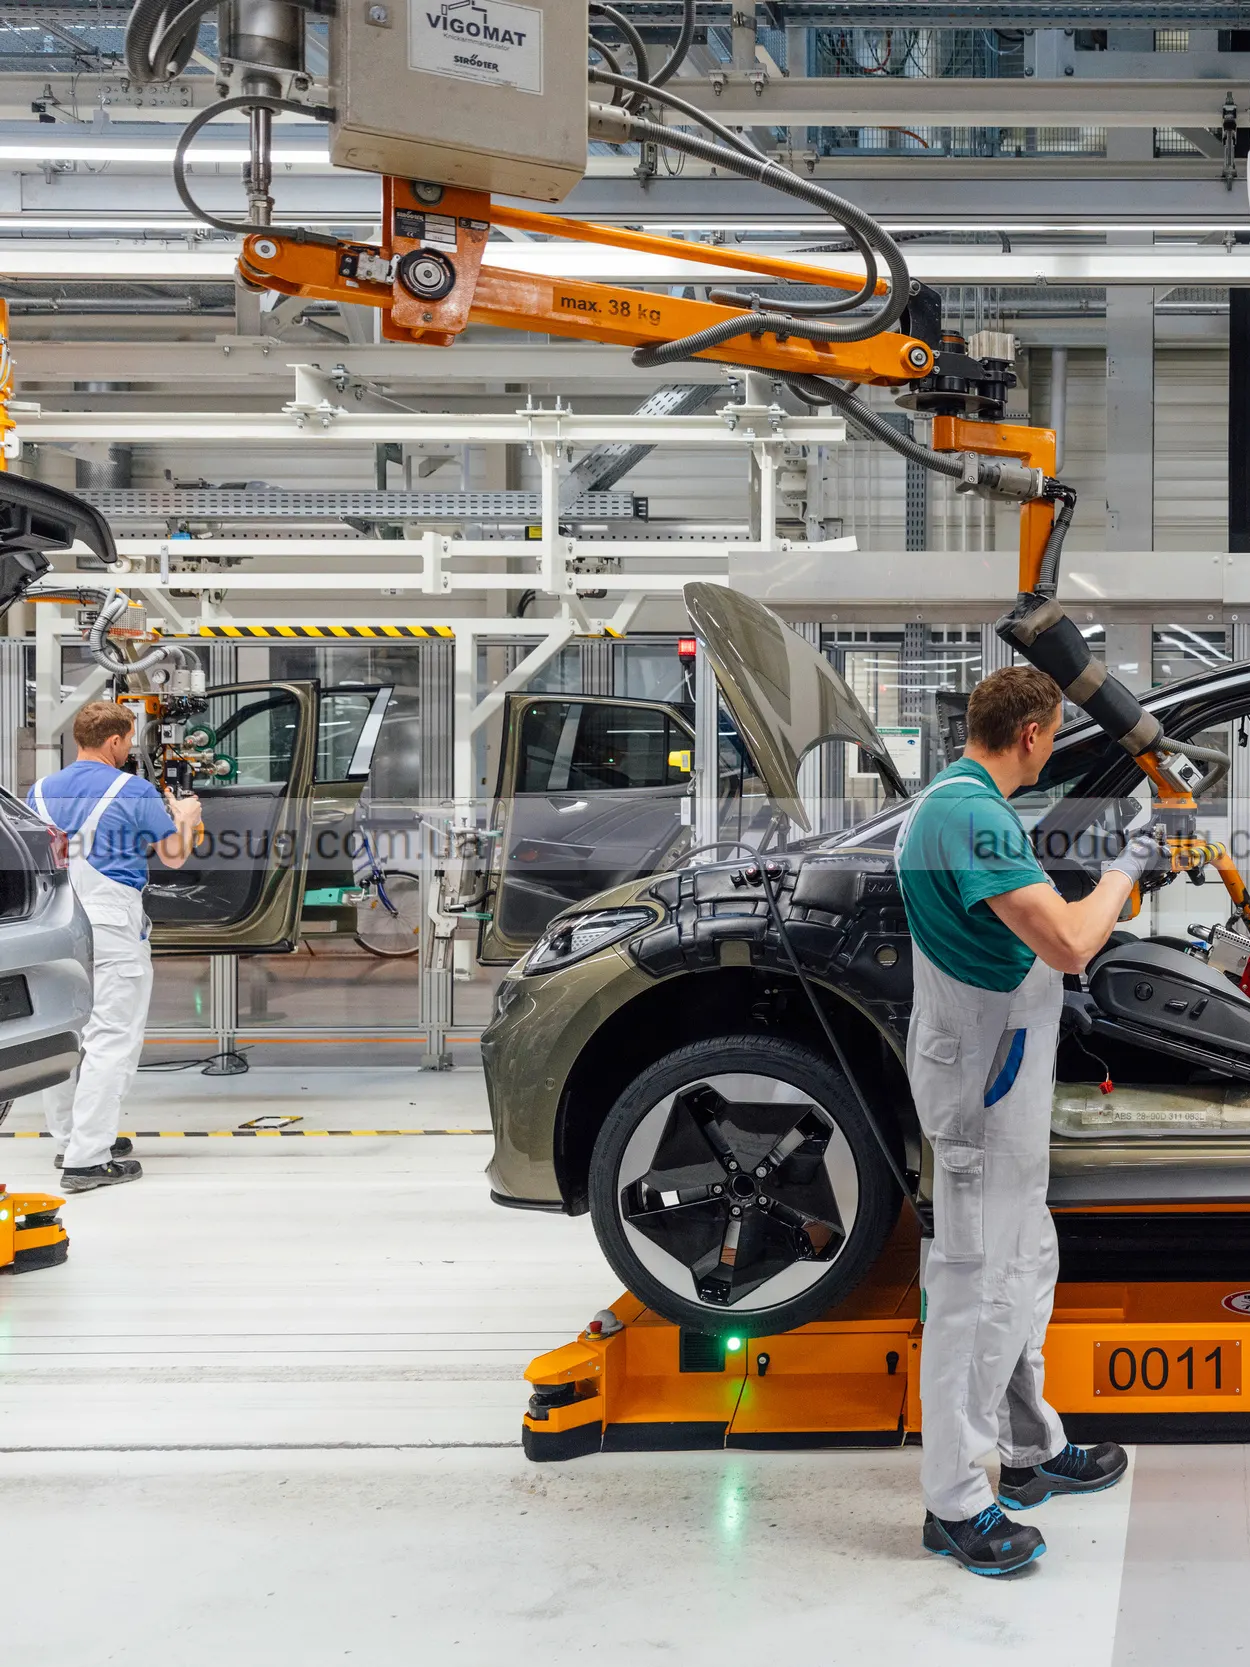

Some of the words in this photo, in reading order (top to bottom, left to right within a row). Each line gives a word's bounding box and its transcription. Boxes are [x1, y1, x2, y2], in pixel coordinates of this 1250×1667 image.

[426, 12, 527, 47] VIGOMAT
[561, 296, 602, 313] max.
[608, 299, 631, 318] 38
[638, 303, 661, 326] kg
[1114, 1112, 1132, 1120] ABS
[1108, 1346, 1222, 1391] 0011
